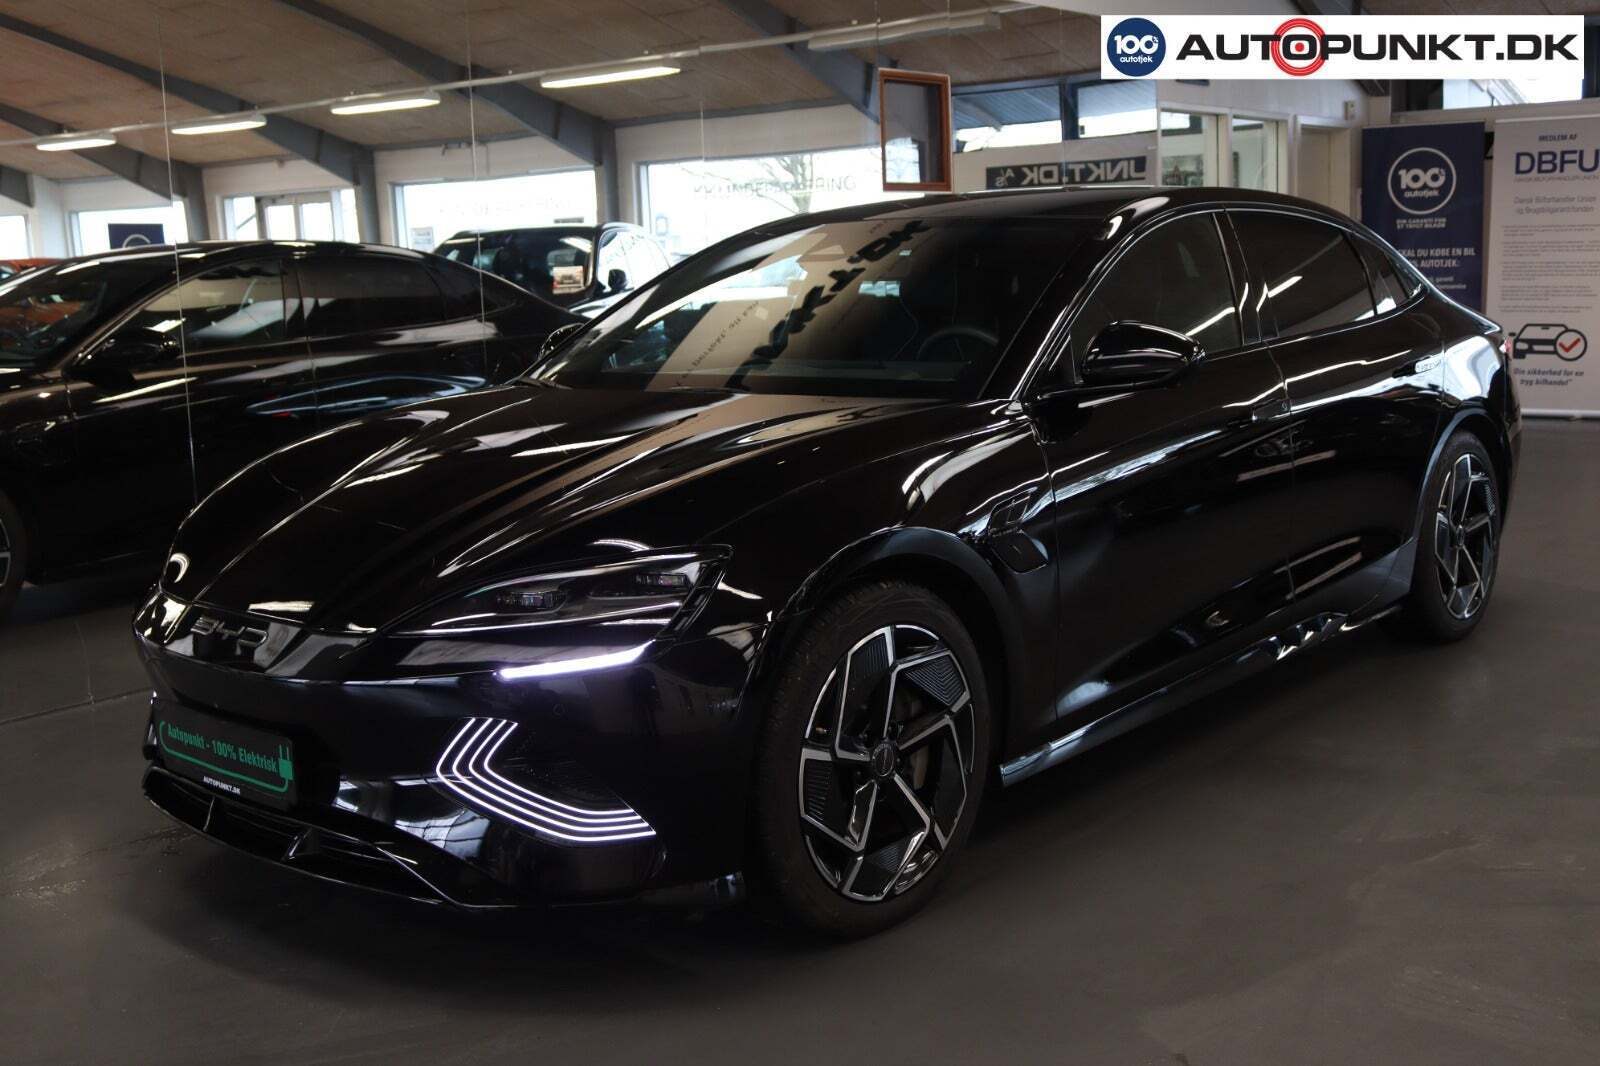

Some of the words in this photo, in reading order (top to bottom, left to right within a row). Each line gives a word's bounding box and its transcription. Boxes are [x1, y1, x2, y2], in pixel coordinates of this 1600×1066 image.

[1515, 149, 1600, 175] DBFU
[168, 723, 205, 750] Autopunkt
[212, 740, 237, 761] 100%
[239, 747, 279, 773] Elektrisk
[203, 776, 241, 795] AUTOPUNKT.DK
